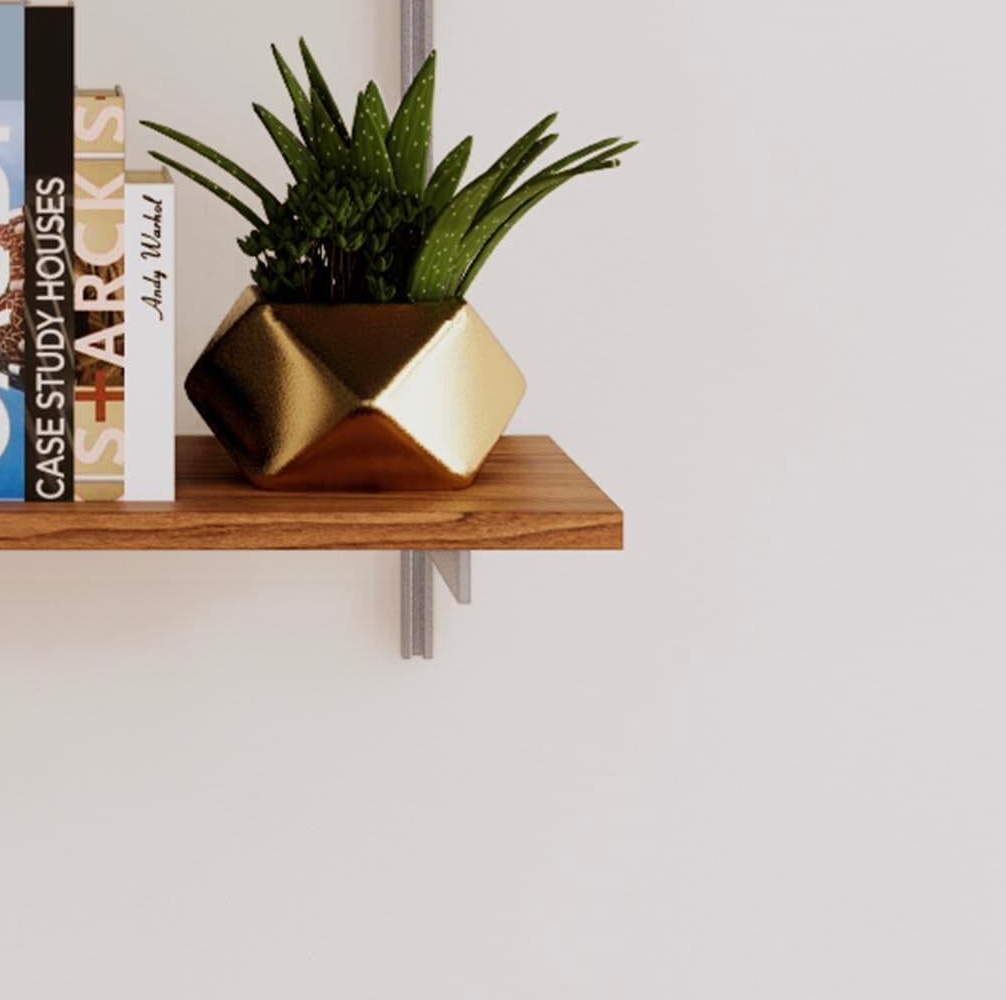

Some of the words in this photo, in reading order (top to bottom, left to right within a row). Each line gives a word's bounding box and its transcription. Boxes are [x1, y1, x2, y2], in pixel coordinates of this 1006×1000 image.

[35, 175, 66, 302] HOUSES
[140, 194, 163, 263] Warhol
[141, 269, 168, 322] Andy
[35, 309, 66, 410] STUDY
[35, 416, 66, 500] CASE
